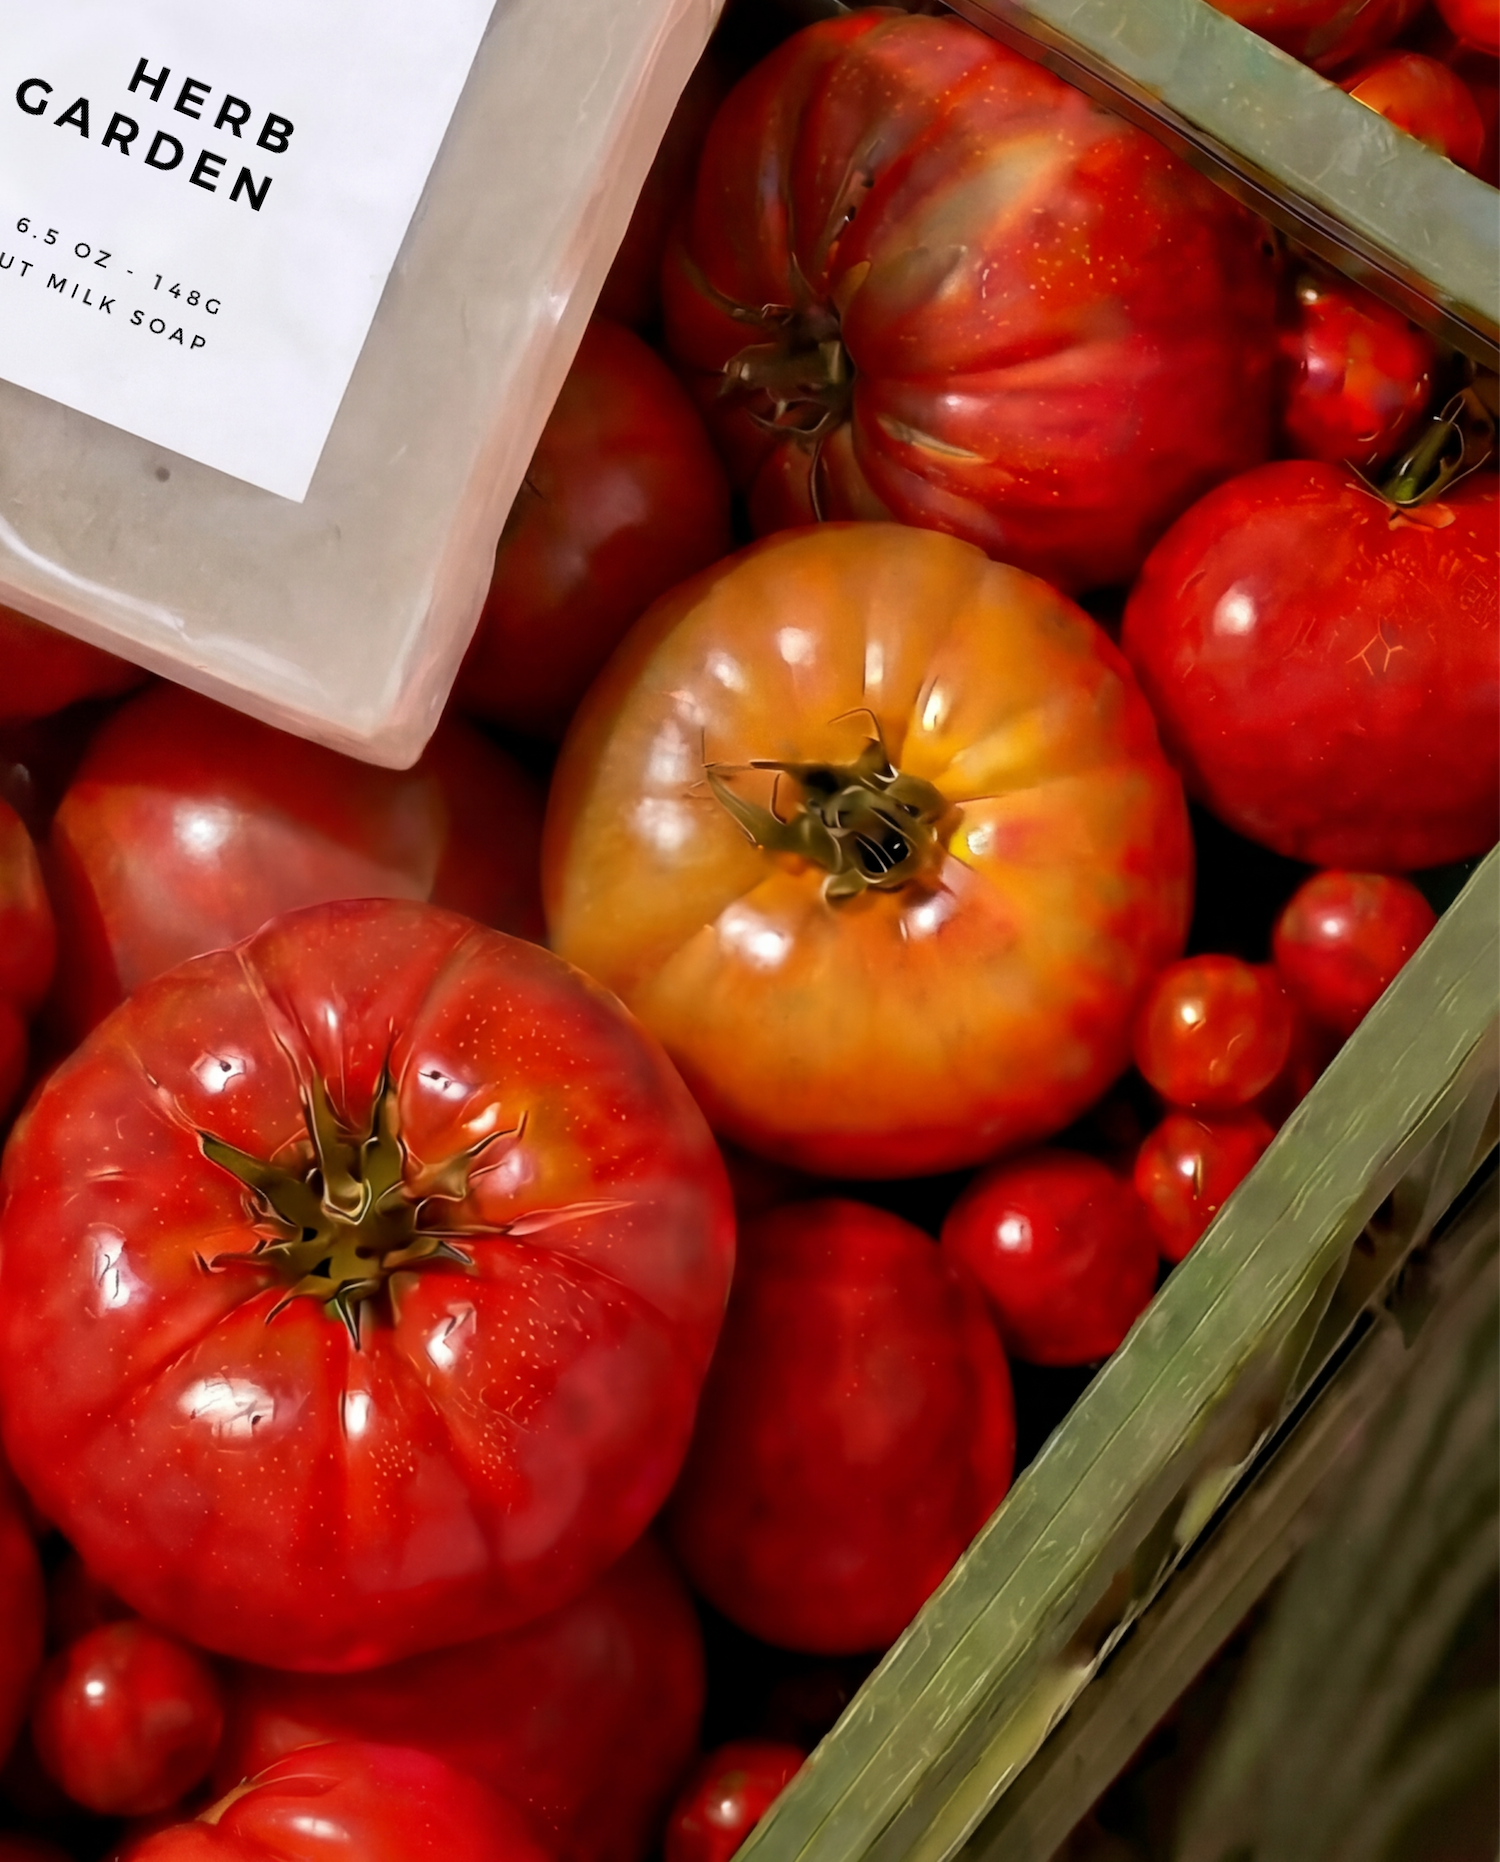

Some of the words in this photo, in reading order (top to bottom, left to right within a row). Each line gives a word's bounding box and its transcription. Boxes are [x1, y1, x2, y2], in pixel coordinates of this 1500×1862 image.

[15, 77, 273, 212] GARDEN
[127, 57, 295, 154] HERB
[15, 217, 60, 246] 6.5
[73, 241, 113, 270] OZ
[153, 273, 222, 316] 148G
[46, 272, 117, 315] MILK
[130, 309, 207, 351] SOAP
